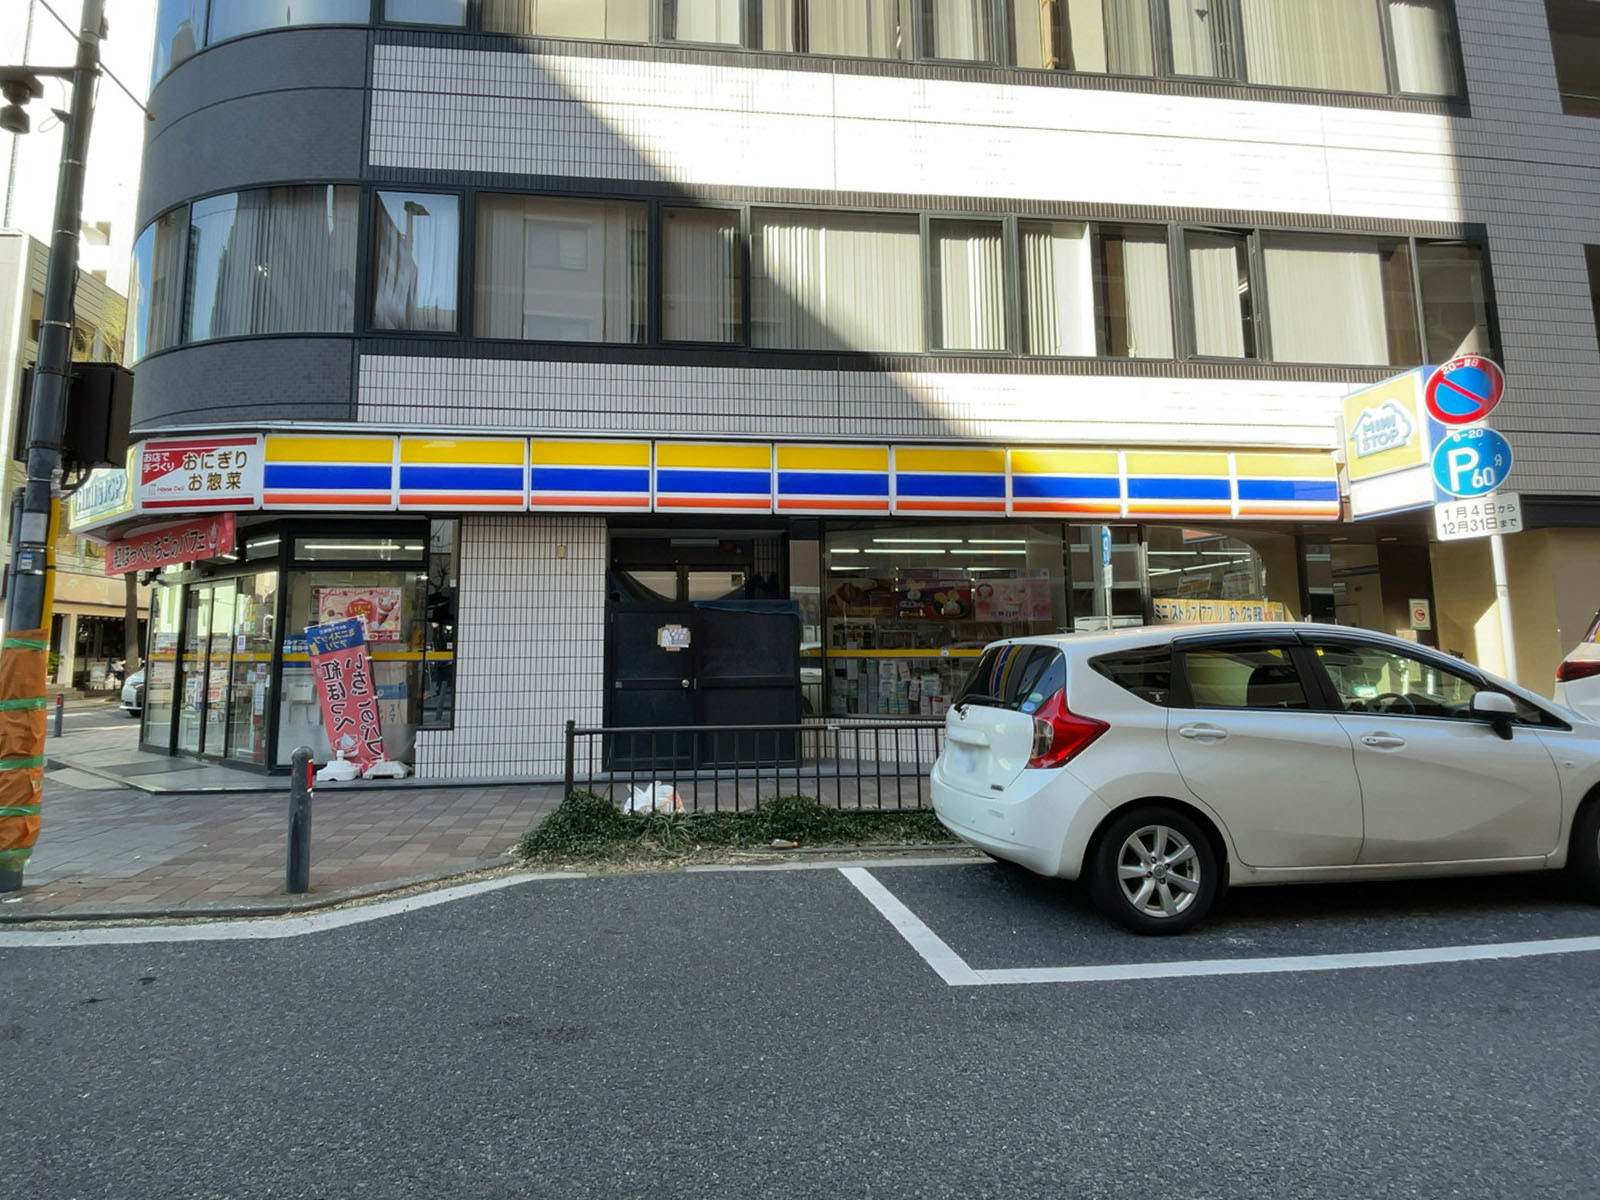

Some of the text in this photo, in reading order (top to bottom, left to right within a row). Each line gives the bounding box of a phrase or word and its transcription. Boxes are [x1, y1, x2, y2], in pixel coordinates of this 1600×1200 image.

[1363, 429, 1399, 451] STOP
[143, 452, 170, 463] お店で
[143, 461, 175, 473] 手づくり
[183, 450, 248, 471] おにぎり
[1448, 447, 1496, 492] P 60
[188, 471, 242, 491] お惣菜
[1442, 517, 1517, 535] 12月31日まで
